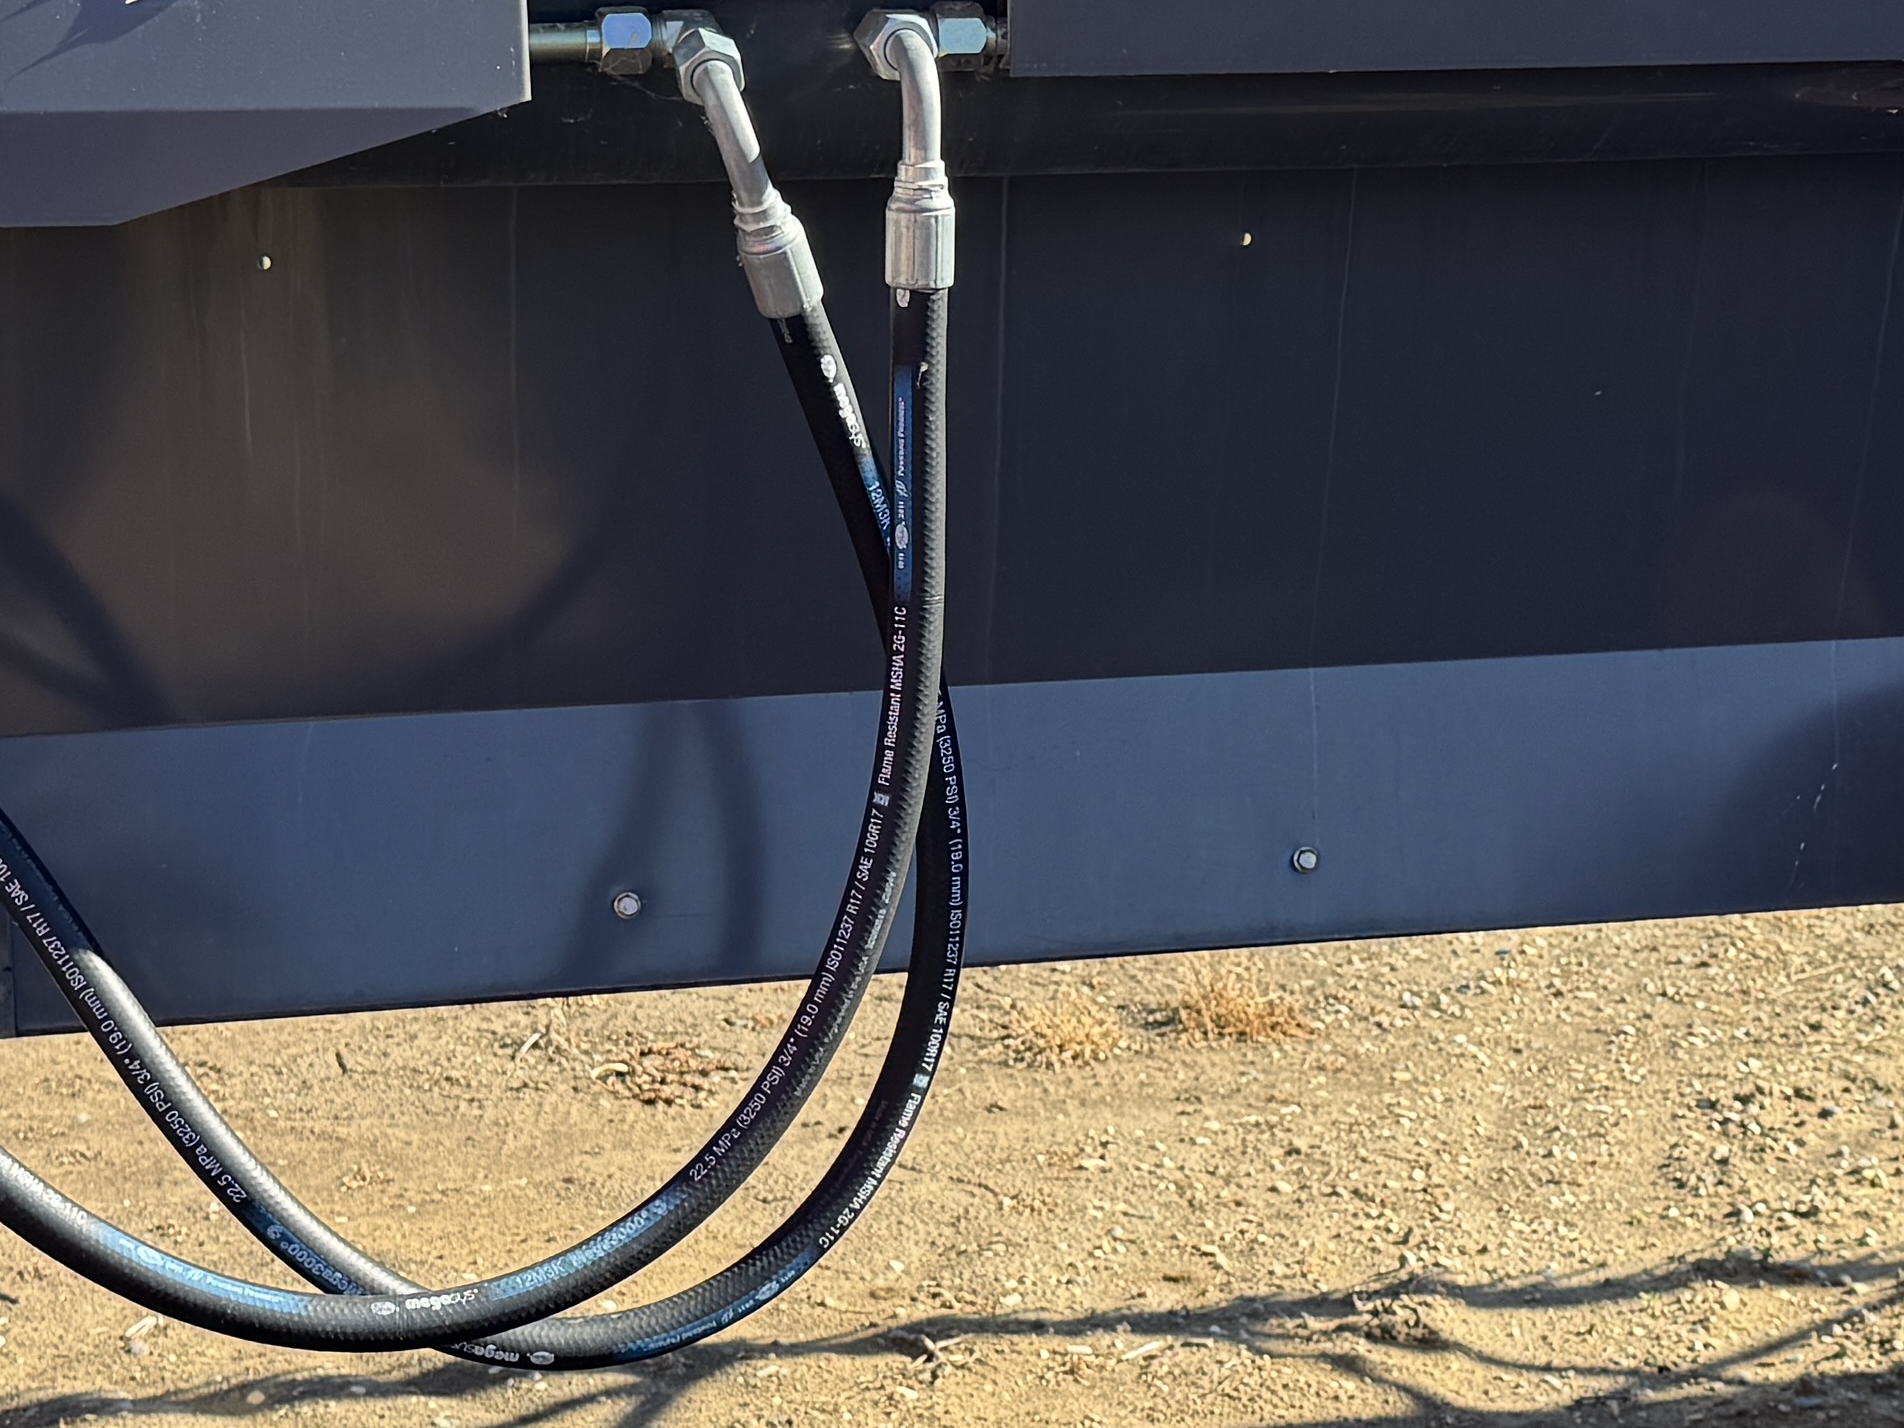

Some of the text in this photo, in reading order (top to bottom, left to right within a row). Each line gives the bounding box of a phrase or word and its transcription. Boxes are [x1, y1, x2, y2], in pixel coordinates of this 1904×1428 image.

[892, 605, 907, 652] 2G-11C
[890, 654, 904, 691] MSHA
[883, 693, 902, 747] Resistant
[877, 750, 894, 786] Flame
[936, 735, 956, 773] (3250
[945, 775, 960, 804] PSI)
[863, 808, 884, 859] 100R17
[947, 807, 962, 834] 3/4"
[856, 856, 873, 882] SAE
[948, 839, 964, 874] (19.0
[5, 879, 30, 906] SAE
[846, 890, 863, 915] R17
[949, 876, 963, 906] mm)
[26, 912, 50, 938] R17
[813, 971, 836, 1004] mm)
[941, 968, 957, 991] R17
[79, 987, 108, 1020] mm)
[933, 1001, 950, 1025] SAE
[794, 1003, 819, 1038] (19.0
[100, 1020, 133, 1055] (19.0
[778, 1037, 798, 1068] 3/4"
[921, 1027, 944, 1072] 100R17
[124, 1058, 151, 1085] 3/4"
[760, 1066, 786, 1095] PSI)
[143, 1081, 172, 1113] PSI)
[736, 1092, 767, 1129] (3250
[901, 1092, 921, 1128] Flame
[165, 1110, 200, 1148] (3250
[712, 1127, 741, 1157] MPa
[195, 1145, 223, 1177] MPa
[689, 1153, 717, 1182] 22.5
[871, 1125, 906, 1179] Resistant
[217, 1174, 247, 1204] 22.5
[849, 1175, 880, 1218] MSHA
[819, 1207, 855, 1249] 2G-11C
[452, 1342, 520, 1363] megasy
